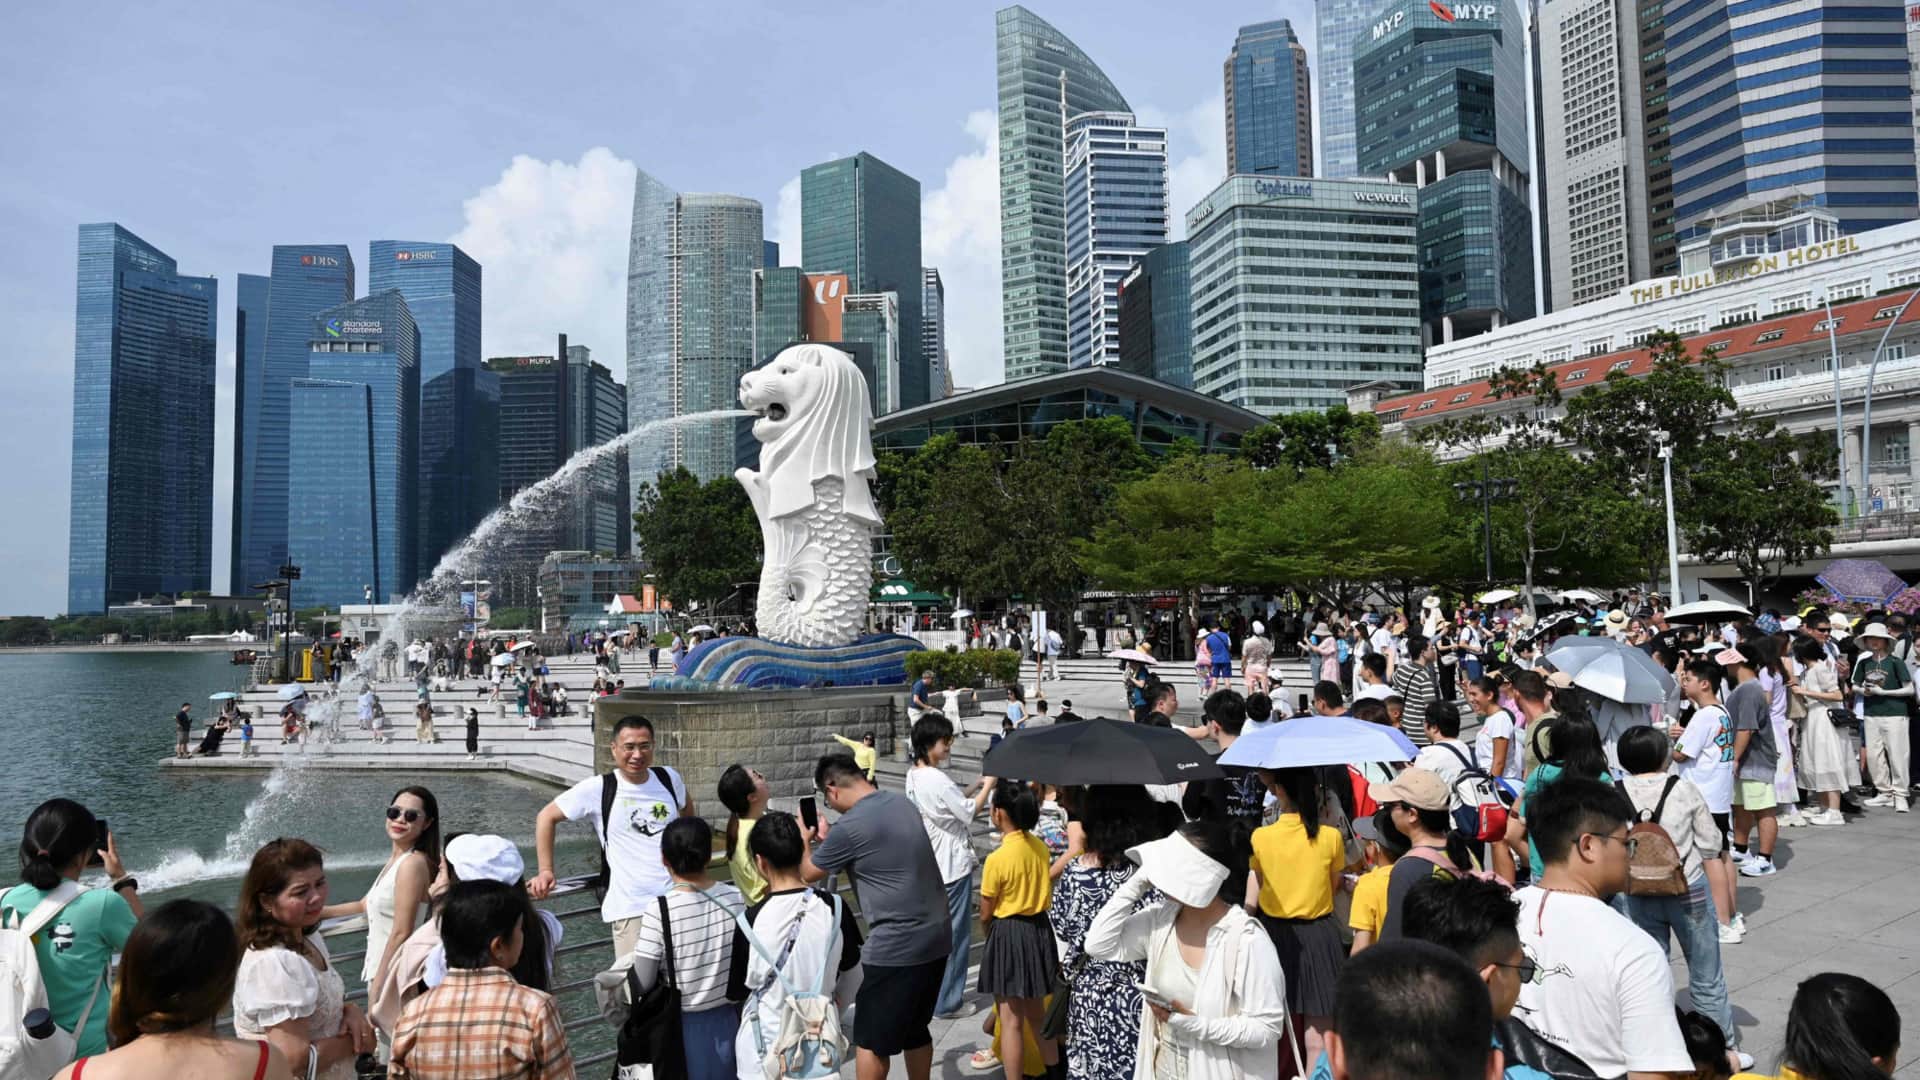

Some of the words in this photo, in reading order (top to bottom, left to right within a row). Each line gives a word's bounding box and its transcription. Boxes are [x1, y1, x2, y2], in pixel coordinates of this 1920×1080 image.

[1455, 4, 1495, 19] MYP
[1373, 11, 1404, 40] MYP
[313, 255, 338, 266] DBS
[1631, 283, 1664, 304] THE
[1670, 255, 1778, 296] FULLERTON
[1787, 237, 1860, 267] HOTEL
